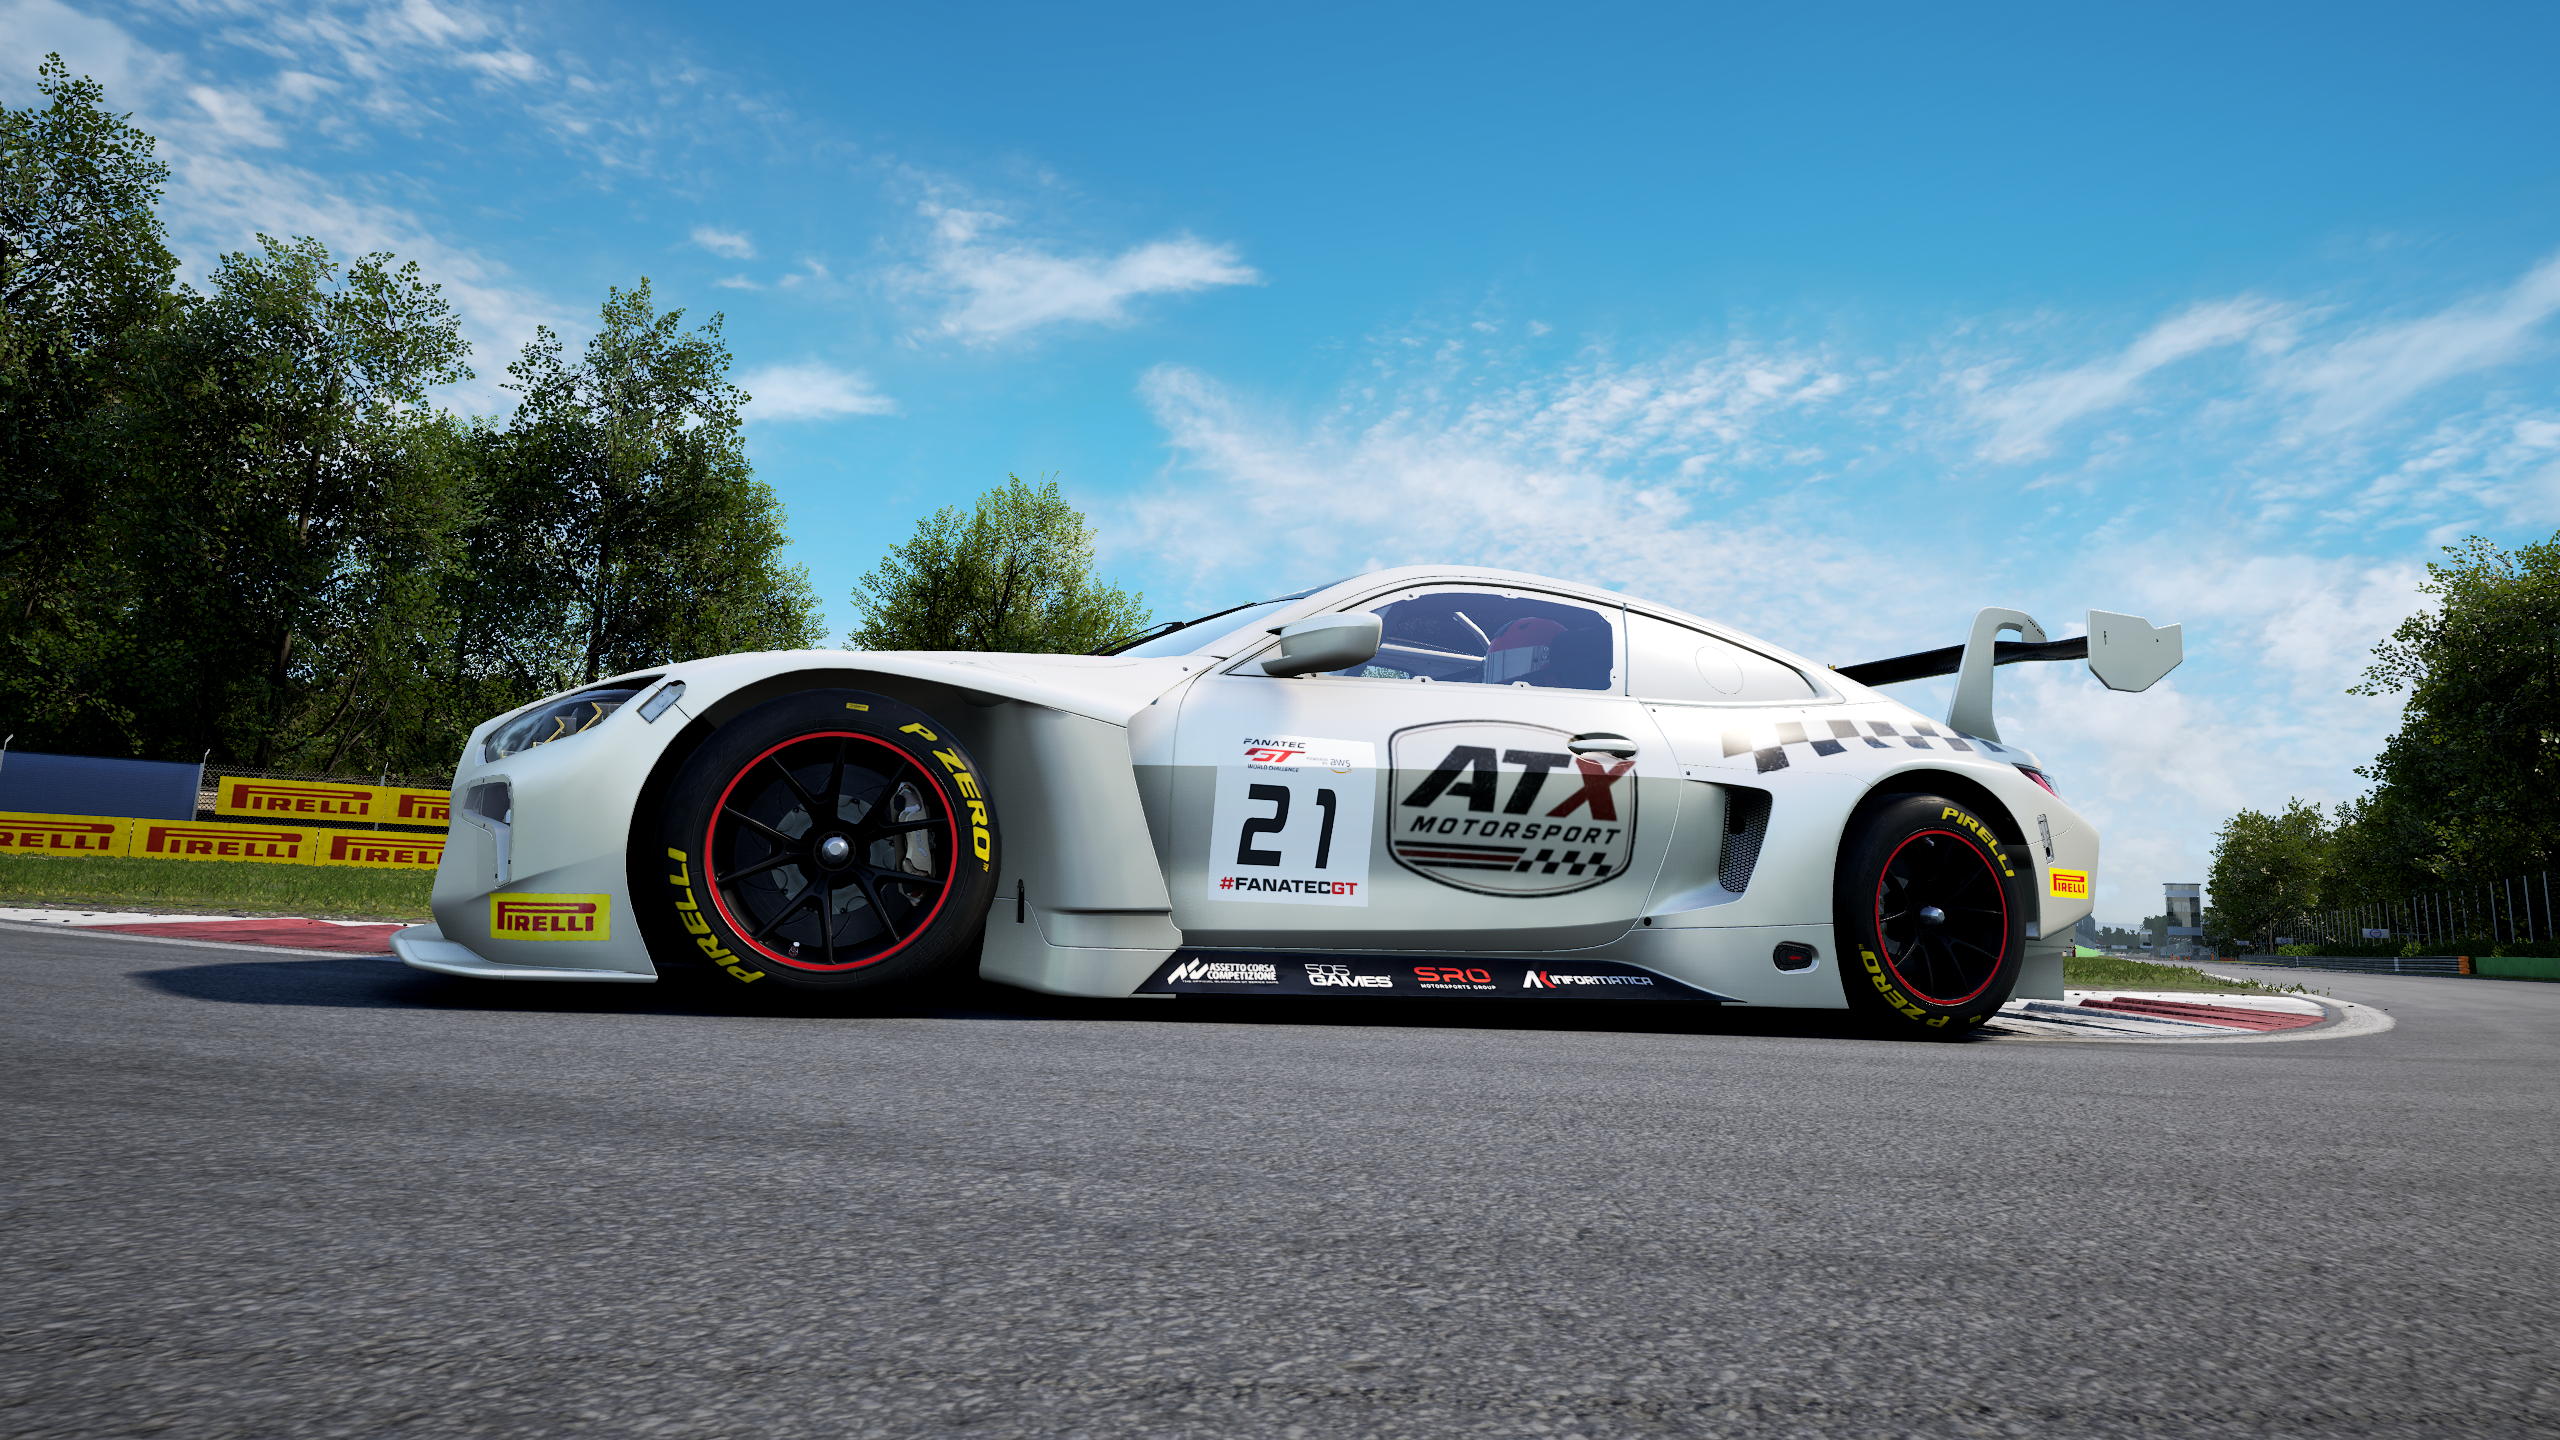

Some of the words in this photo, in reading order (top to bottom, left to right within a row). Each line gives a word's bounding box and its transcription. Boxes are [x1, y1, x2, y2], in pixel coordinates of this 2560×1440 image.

[899, 722, 938, 741] P
[1243, 738, 1306, 749] FANATEC
[1244, 747, 1306, 763] GT
[1330, 758, 1351, 768] aws
[1247, 763, 1268, 771] WORLD
[1268, 765, 1300, 773] CHALLENGE
[1400, 745, 1636, 821] ATX
[231, 784, 373, 816] PIRELLI
[0, 819, 115, 850] RELLI
[1237, 783, 1336, 869] 21
[1409, 816, 1621, 845] MOTORSPORT
[146, 826, 303, 858] PIRELLI
[330, 835, 446, 865] PIREL
[1941, 806, 2015, 878] PIRELLI
[1219, 876, 1358, 895] #FANATECGT
[2053, 873, 2085, 894] PIRELLI
[497, 901, 597, 931] PIRELLI
[668, 847, 766, 983] PIRELLI
[1206, 971, 1277, 981] COMPETIZIONE
[1209, 962, 1247, 973] ASSETTO
[1247, 964, 1276, 973] CORSA
[1304, 963, 1350, 976] 505
[1413, 966, 1492, 983] SRO
[1308, 975, 1393, 988] GAMES
[1926, 1016, 1950, 1028] P
